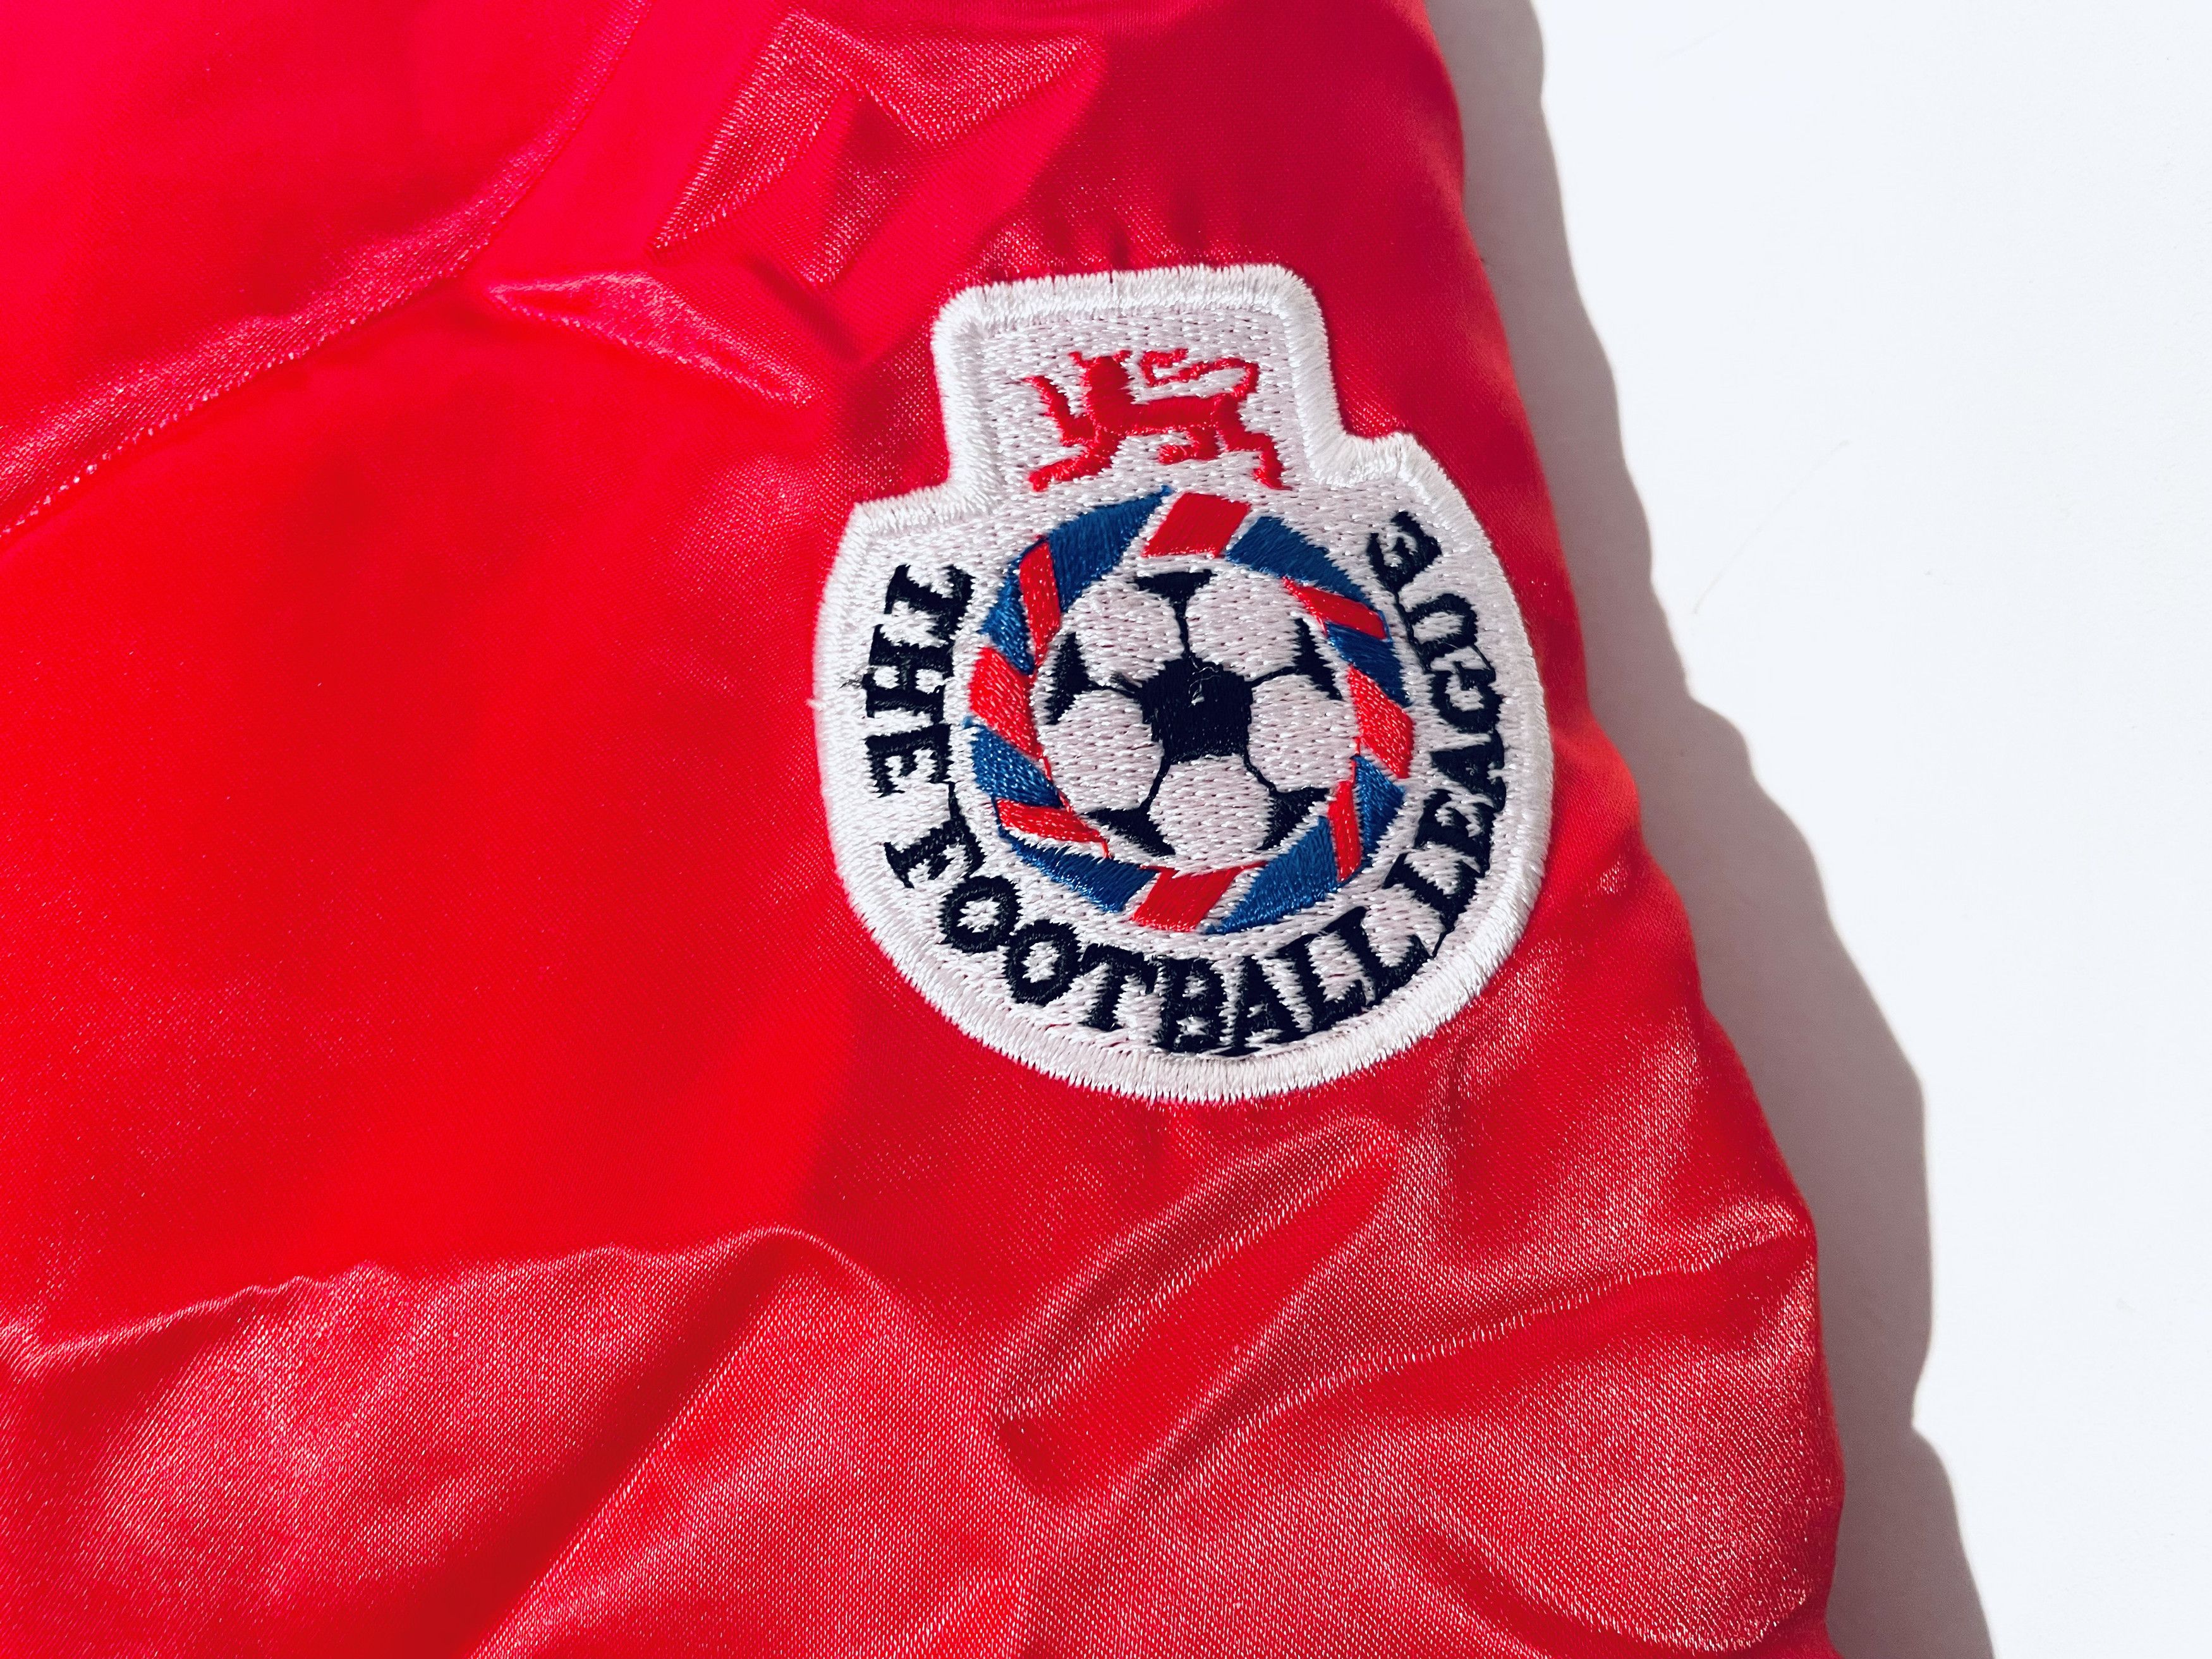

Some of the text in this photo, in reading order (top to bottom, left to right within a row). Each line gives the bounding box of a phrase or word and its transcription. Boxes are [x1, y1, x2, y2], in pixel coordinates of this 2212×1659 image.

[863, 511, 1507, 1056] THE FOOTBALL LEAGUE
